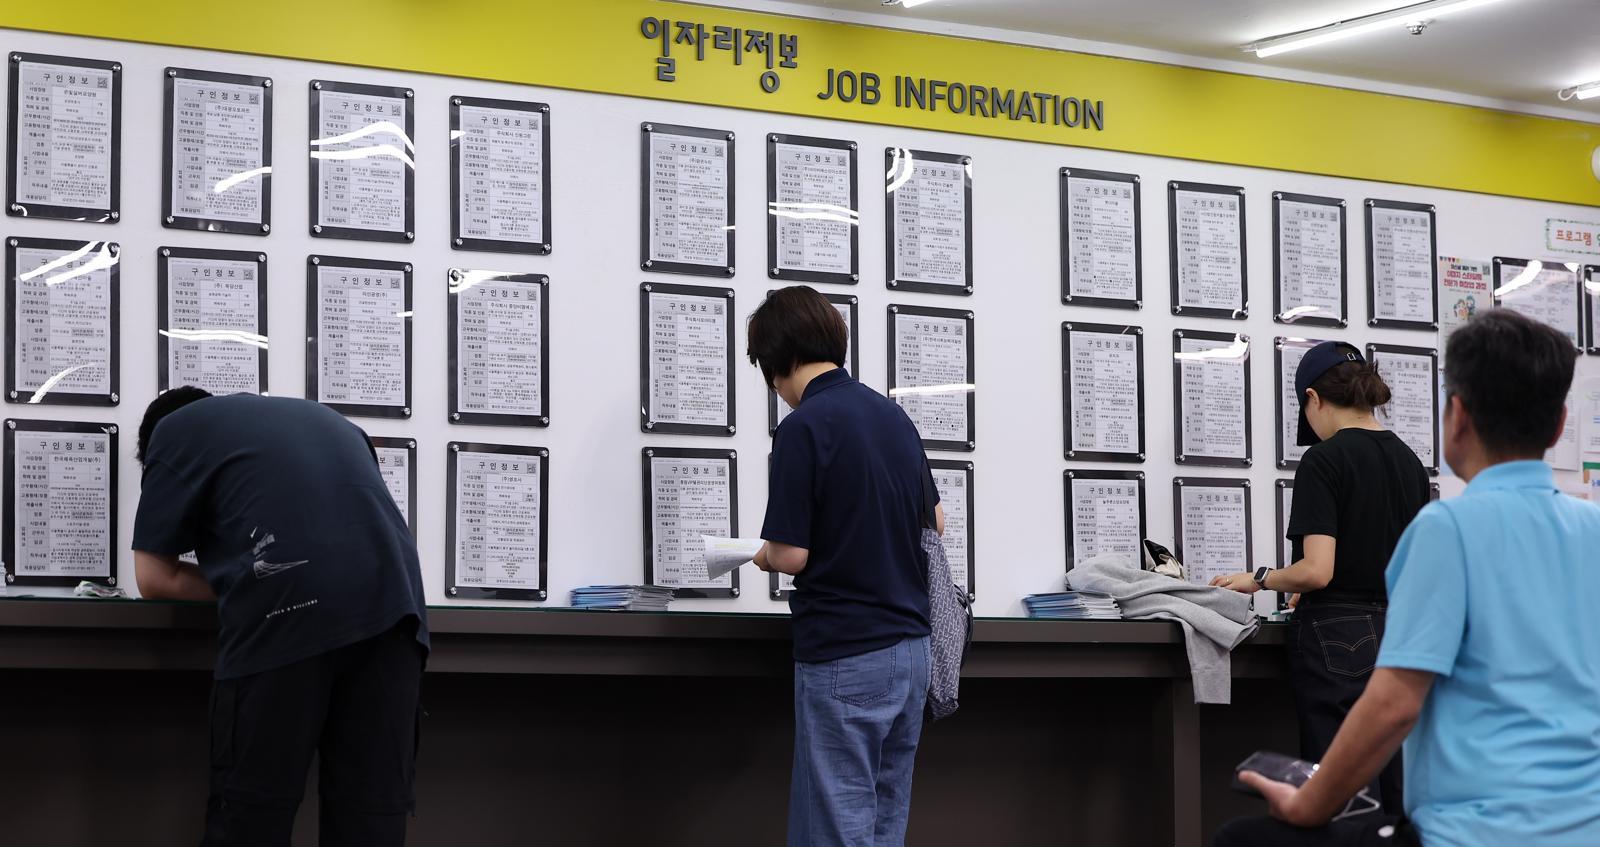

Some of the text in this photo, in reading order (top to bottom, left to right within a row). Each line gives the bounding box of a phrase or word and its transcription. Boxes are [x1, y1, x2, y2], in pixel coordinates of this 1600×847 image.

[640, 16, 798, 94] 일자리정보
[817, 68, 1105, 132] JOB INFORMATION
[1555, 229, 1592, 246] 프로그램
